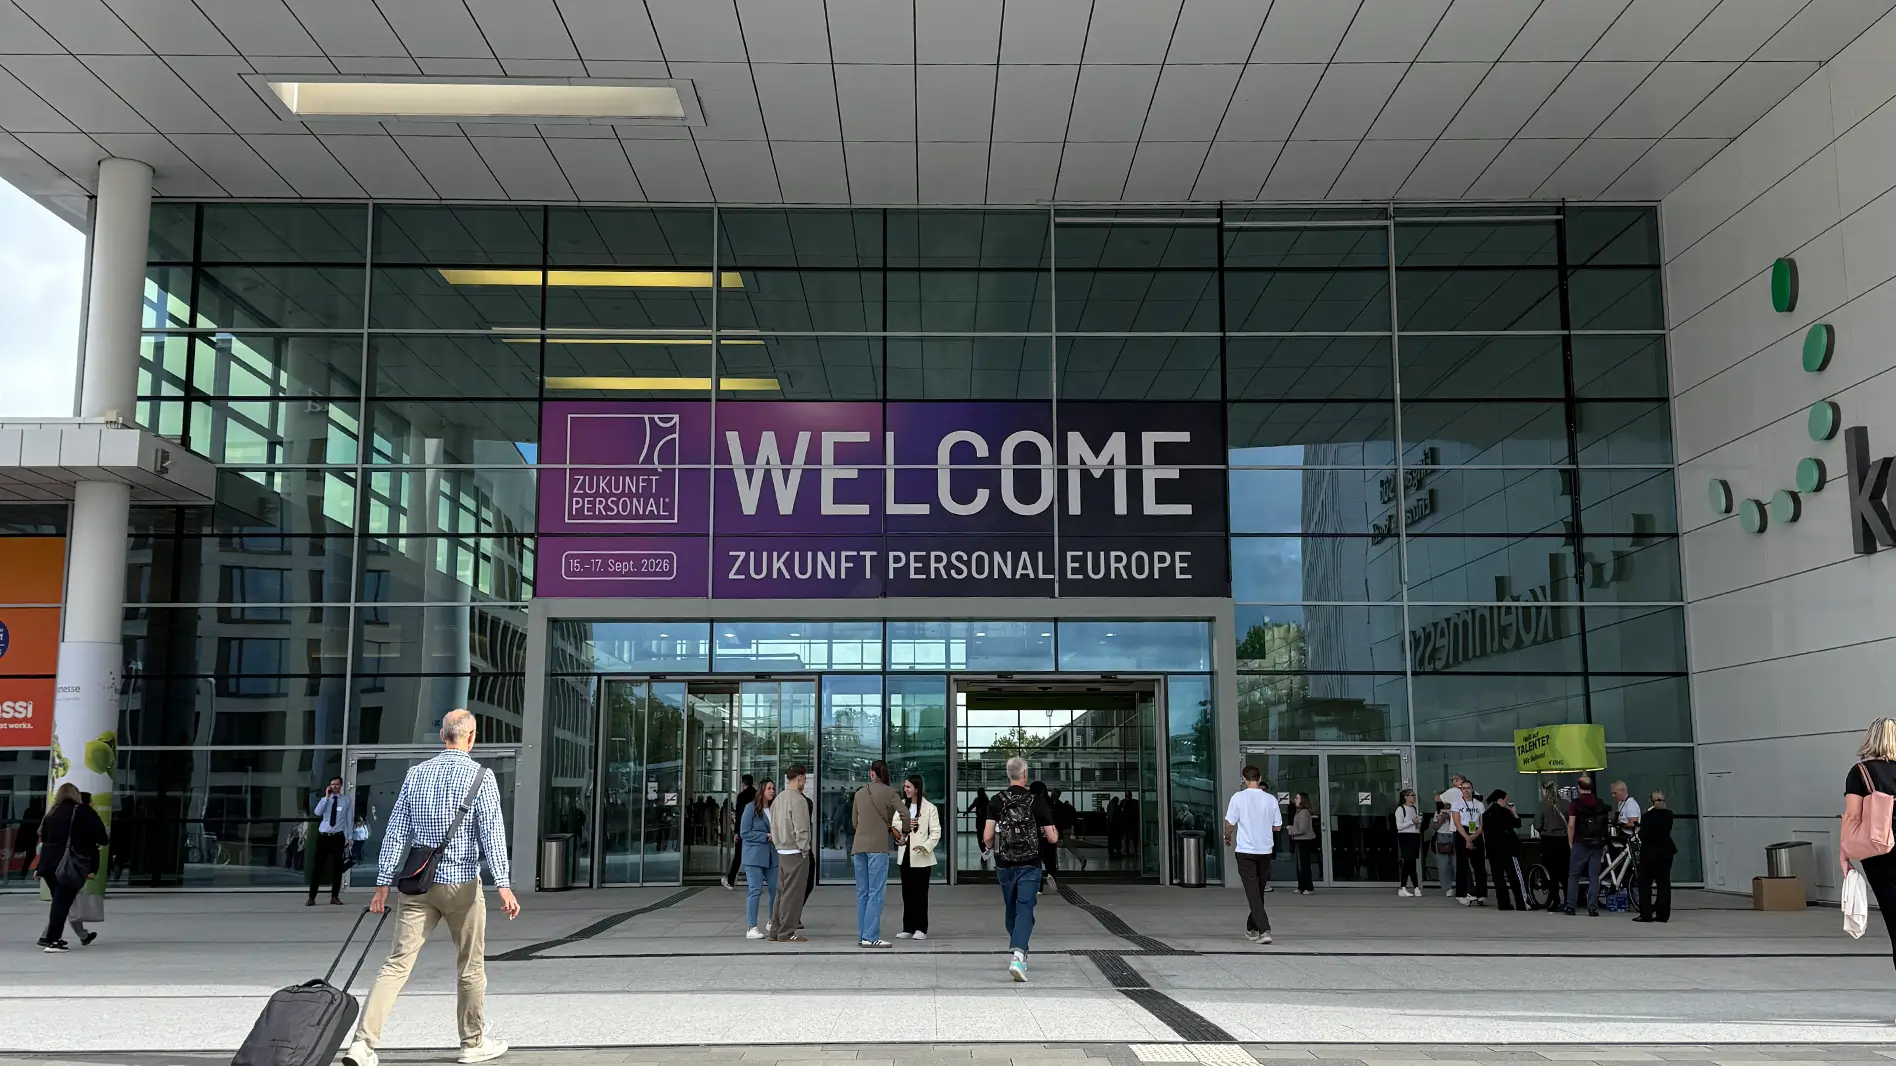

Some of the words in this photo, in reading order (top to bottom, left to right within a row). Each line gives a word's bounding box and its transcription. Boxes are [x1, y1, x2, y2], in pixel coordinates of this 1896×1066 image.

[725, 430, 1193, 516] WELCOME
[573, 476, 660, 494] ZUKUNFT
[1844, 426, 1896, 554] k
[608, 559, 637, 575] Sept.
[641, 559, 670, 572] 2026
[728, 551, 878, 580] ZUKUNFT
[888, 551, 1054, 580] PERSONAL
[1066, 551, 1193, 580] EUROPE
[0, 700, 34, 719] ssi
[8, 721, 34, 729] works.
[1516, 734, 1550, 756] TALENTE?
